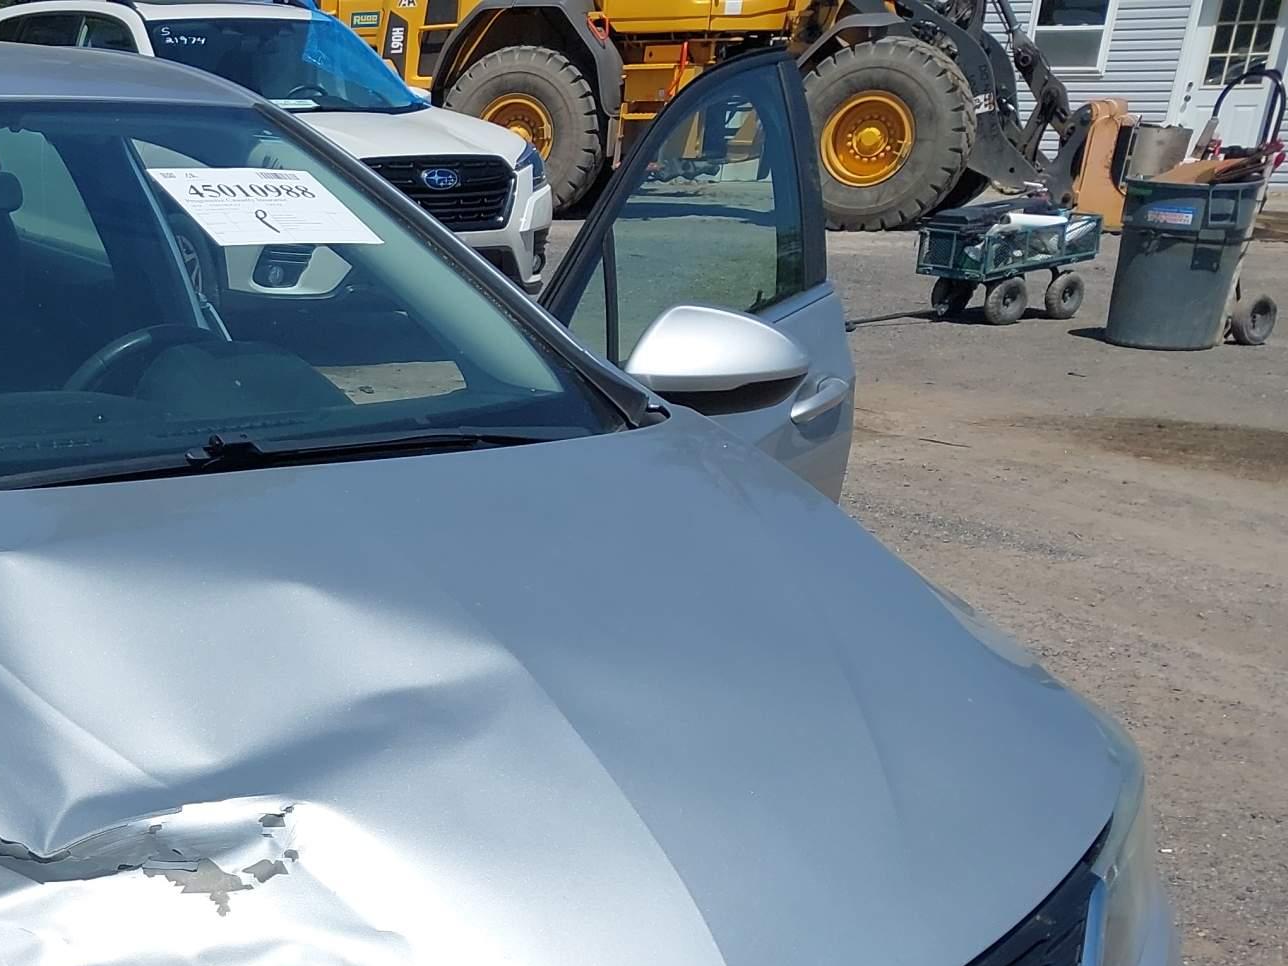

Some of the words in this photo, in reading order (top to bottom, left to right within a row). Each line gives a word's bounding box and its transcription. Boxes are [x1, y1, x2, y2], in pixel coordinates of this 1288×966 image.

[161, 26, 171, 36] S
[391, 27, 405, 54] L90H
[188, 183, 317, 199] 45010988
